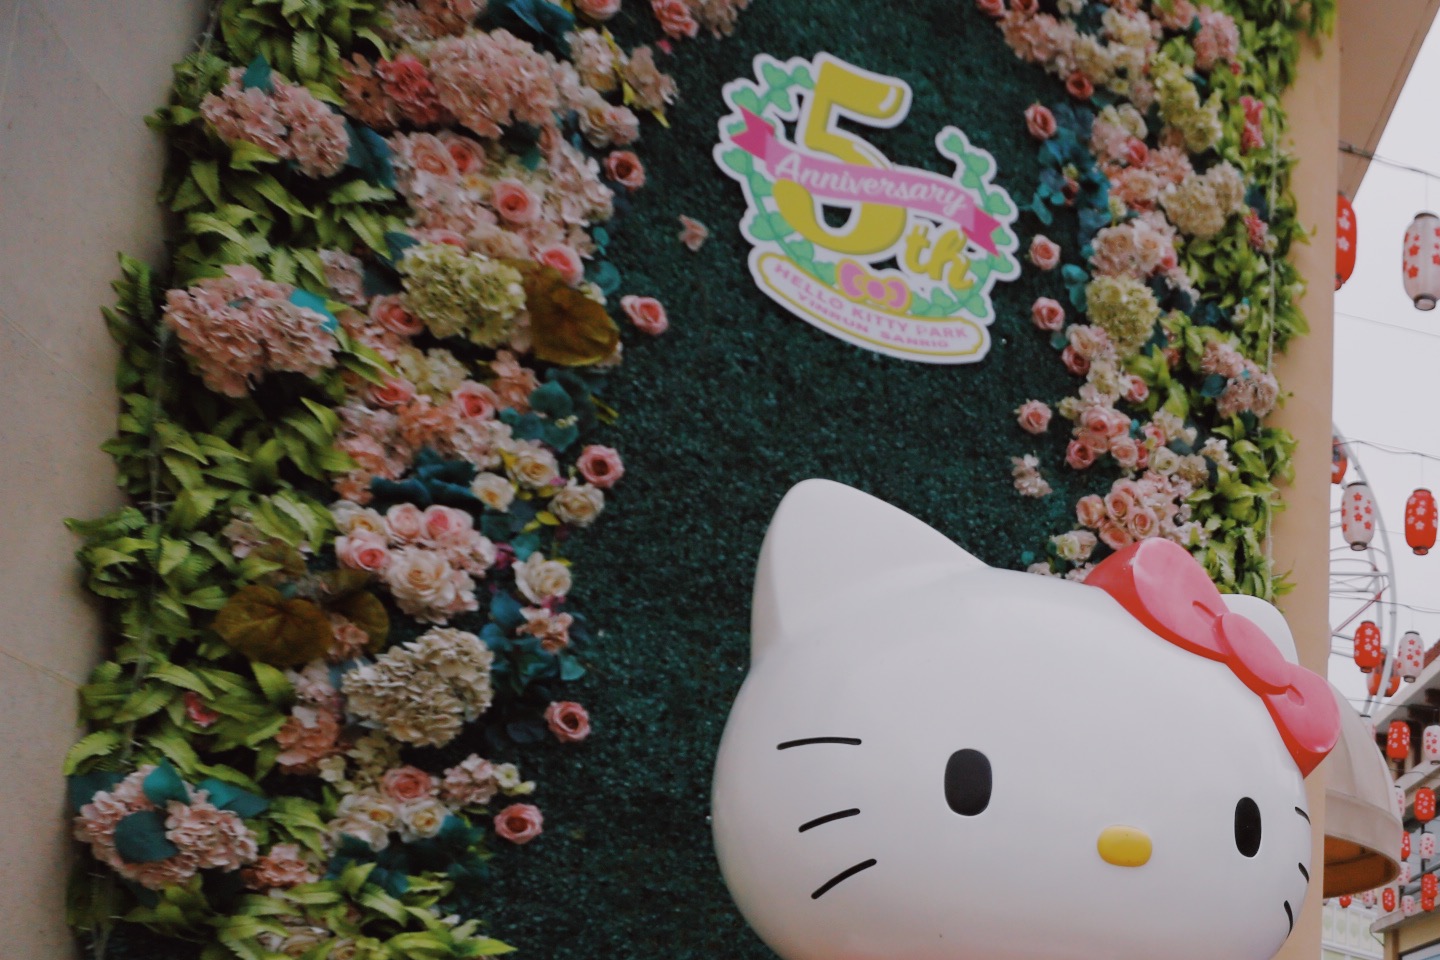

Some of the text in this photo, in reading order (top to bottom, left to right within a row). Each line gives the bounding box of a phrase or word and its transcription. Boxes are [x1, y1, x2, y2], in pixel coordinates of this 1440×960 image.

[774, 155, 967, 214] Anniversary
[774, 263, 968, 338] HELLO KITTY PARK
[880, 330, 950, 348] SANRIO
